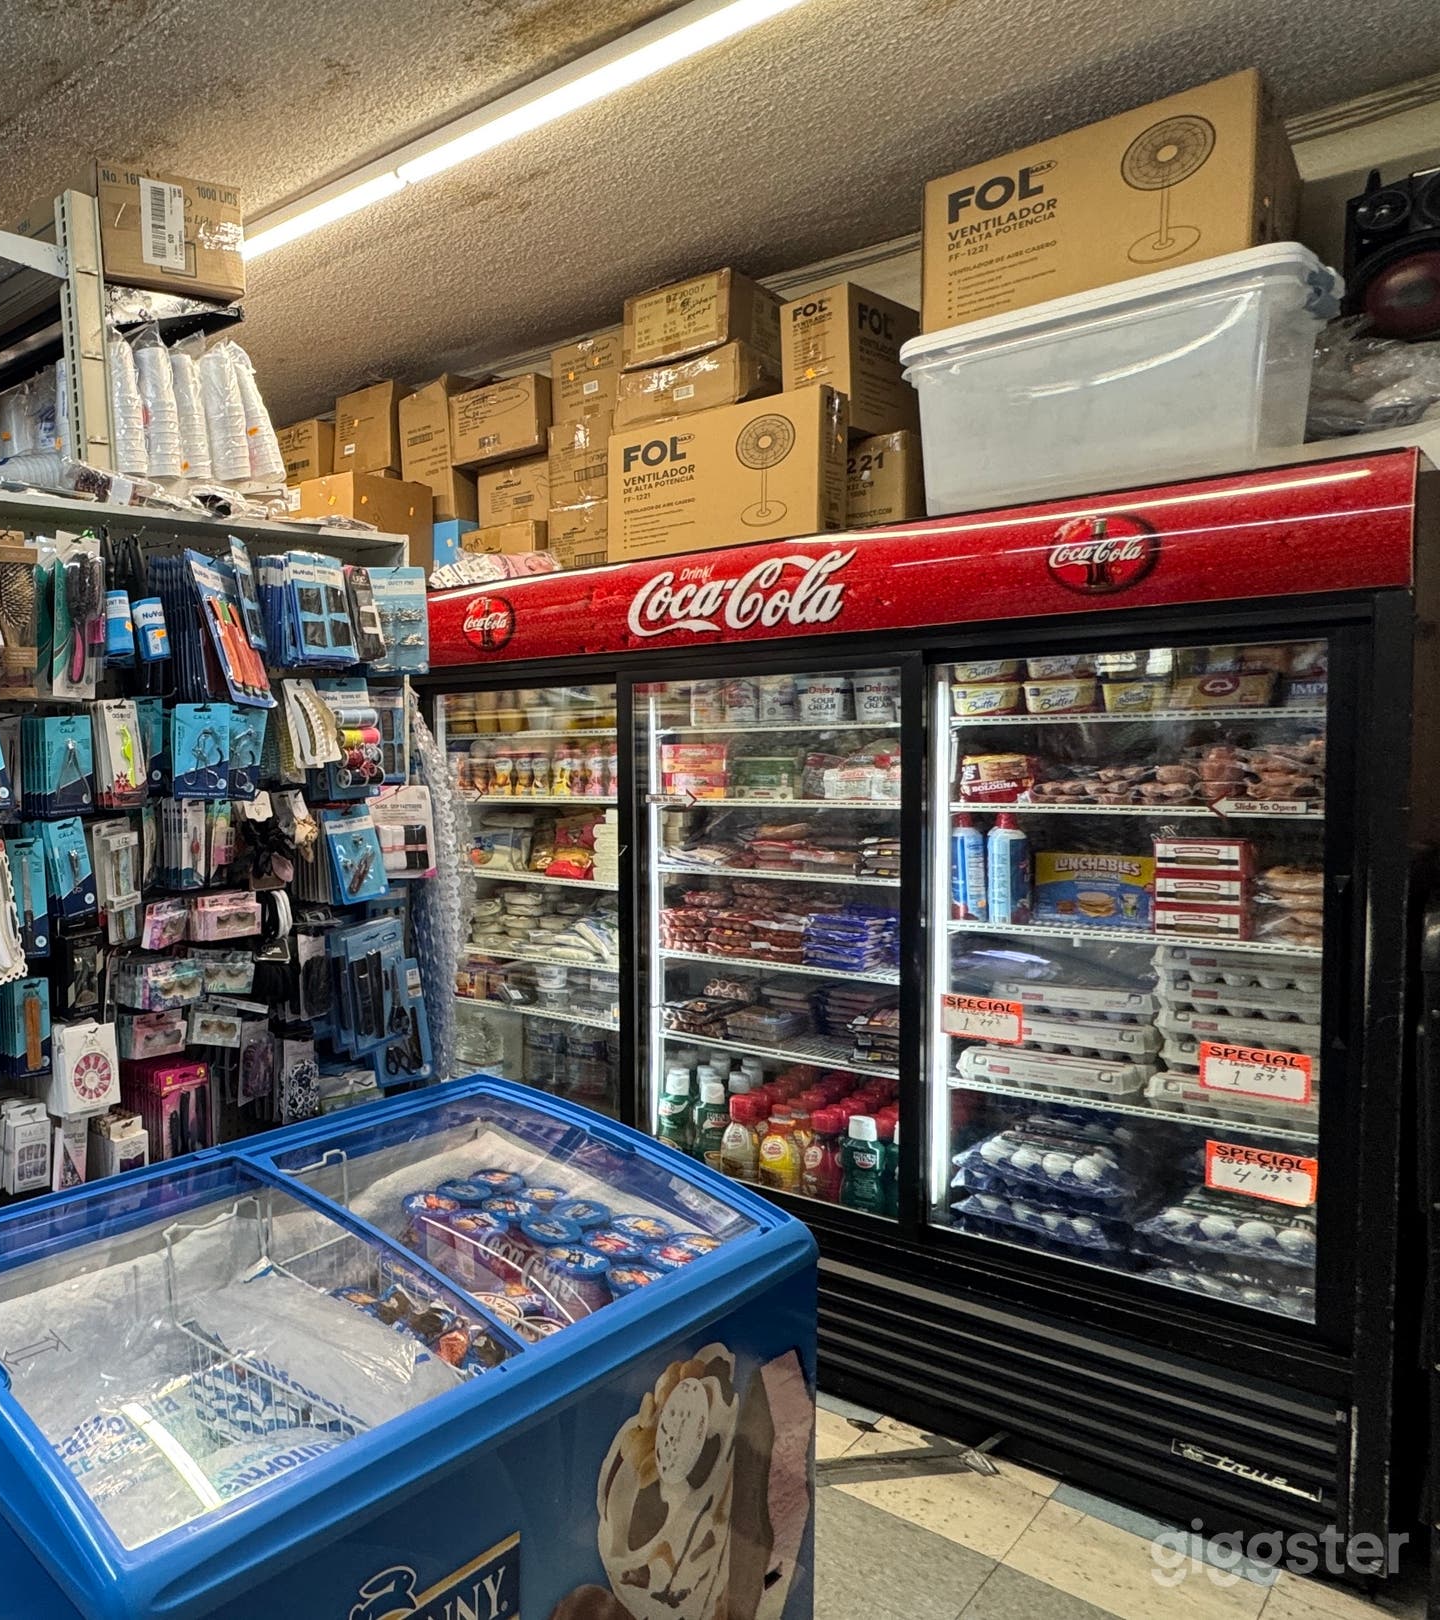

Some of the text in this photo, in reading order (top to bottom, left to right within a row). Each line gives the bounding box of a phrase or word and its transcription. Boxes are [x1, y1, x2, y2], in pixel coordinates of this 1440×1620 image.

[196, 186, 238, 207] 1000 LIDS
[948, 167, 1044, 225] FOL
[948, 198, 1058, 242] VENTILADOR
[948, 212, 1056, 251] DE ALTA POTENCIA
[948, 244, 989, 262] FF-1221
[948, 259, 994, 277] VENTILADOR
[792, 299, 828, 322] FOL
[858, 302, 895, 341] FOL
[623, 436, 687, 474] FOL
[623, 464, 696, 487] VENTILADOR
[634, 482, 654, 493] ALTA
[655, 474, 695, 488] POTENCIA
[1048, 537, 1147, 570] Coca-Cola
[628, 547, 857, 639] Coca-Cola
[462, 613, 508, 634] Coca-Cola
[808, 684, 837, 696] Daisy
[972, 781, 1018, 793] BOLOGNA
[1234, 801, 1298, 814] Slide To Open
[1054, 857, 1141, 877] LUNCHABLES
[946, 996, 1015, 1013] SPECIAL
[1209, 1046, 1301, 1068] SPECIAL
[1216, 1145, 1308, 1172] SPECIAL
